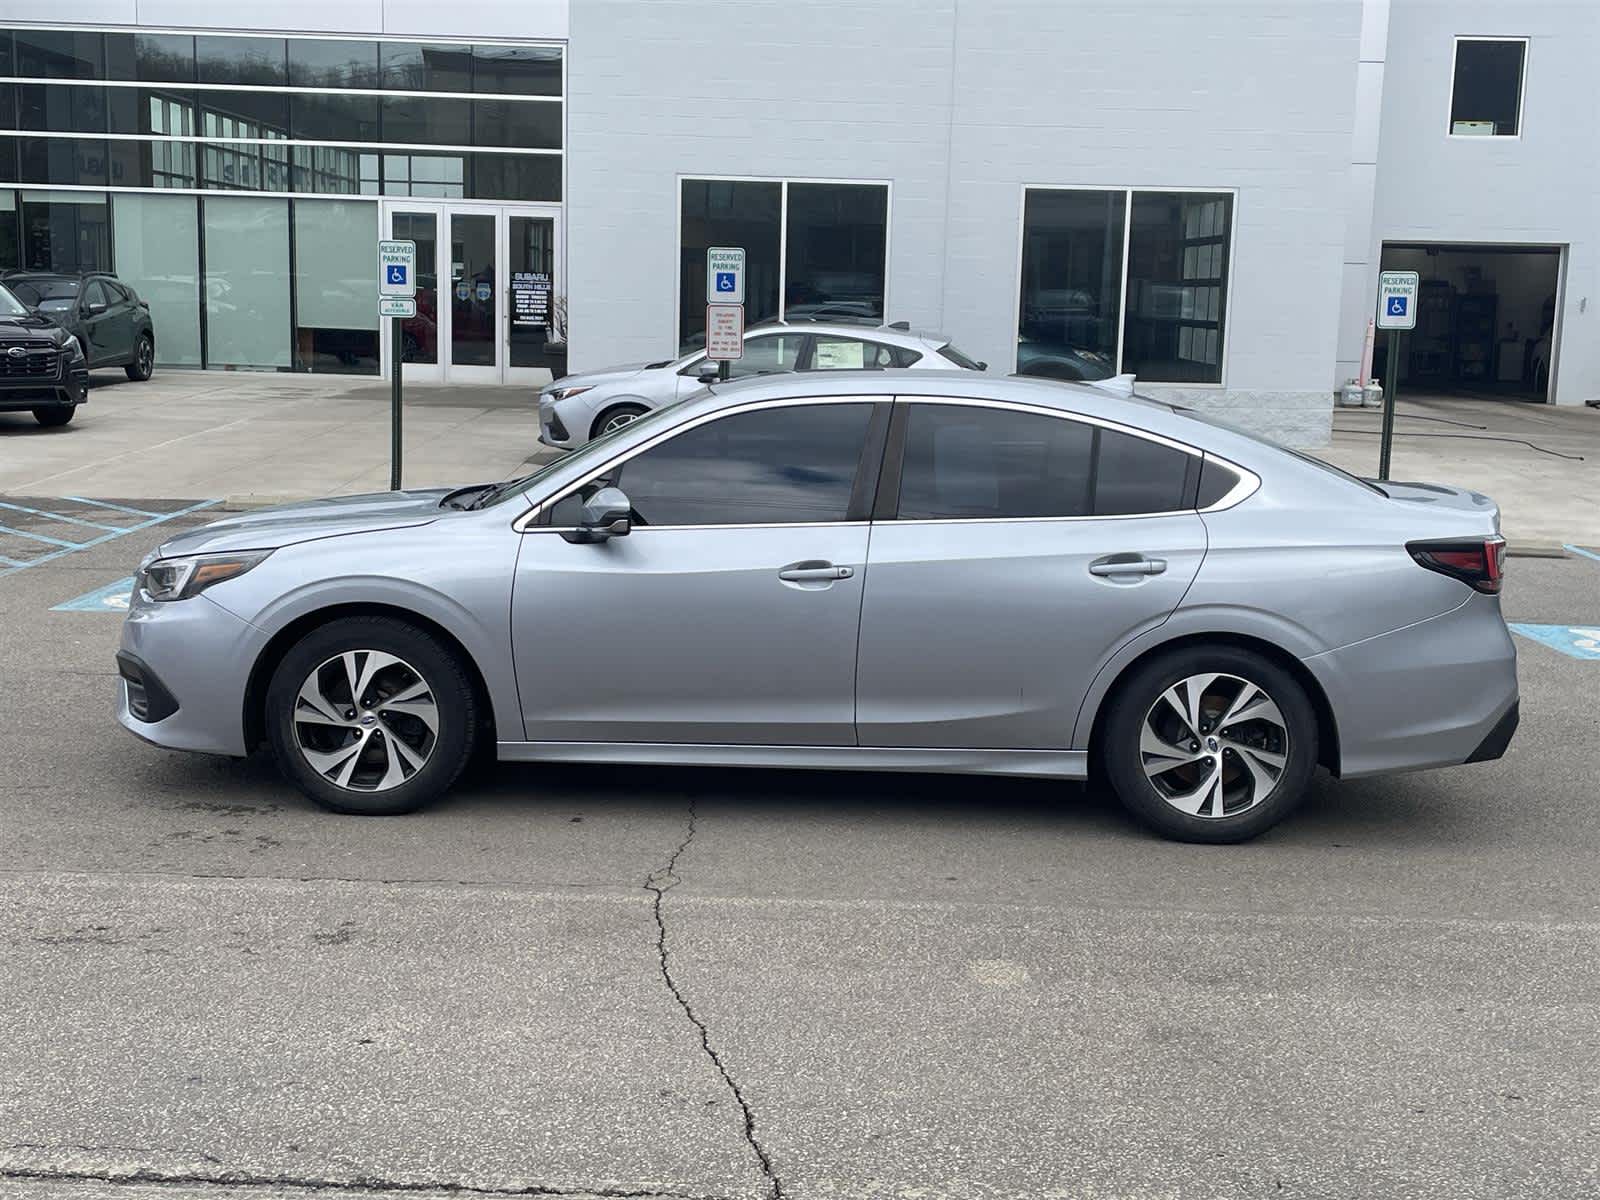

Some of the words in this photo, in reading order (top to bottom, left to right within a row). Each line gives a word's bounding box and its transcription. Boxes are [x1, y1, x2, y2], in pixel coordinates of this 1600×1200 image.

[381, 245, 412, 254] RESERVED
[383, 255, 411, 263] PARKING
[711, 253, 742, 261] RESERVED
[713, 262, 740, 270] PARKING
[514, 272, 549, 281] SUBARU
[1383, 277, 1416, 286] RESERVED
[1384, 287, 1413, 295] PARKING
